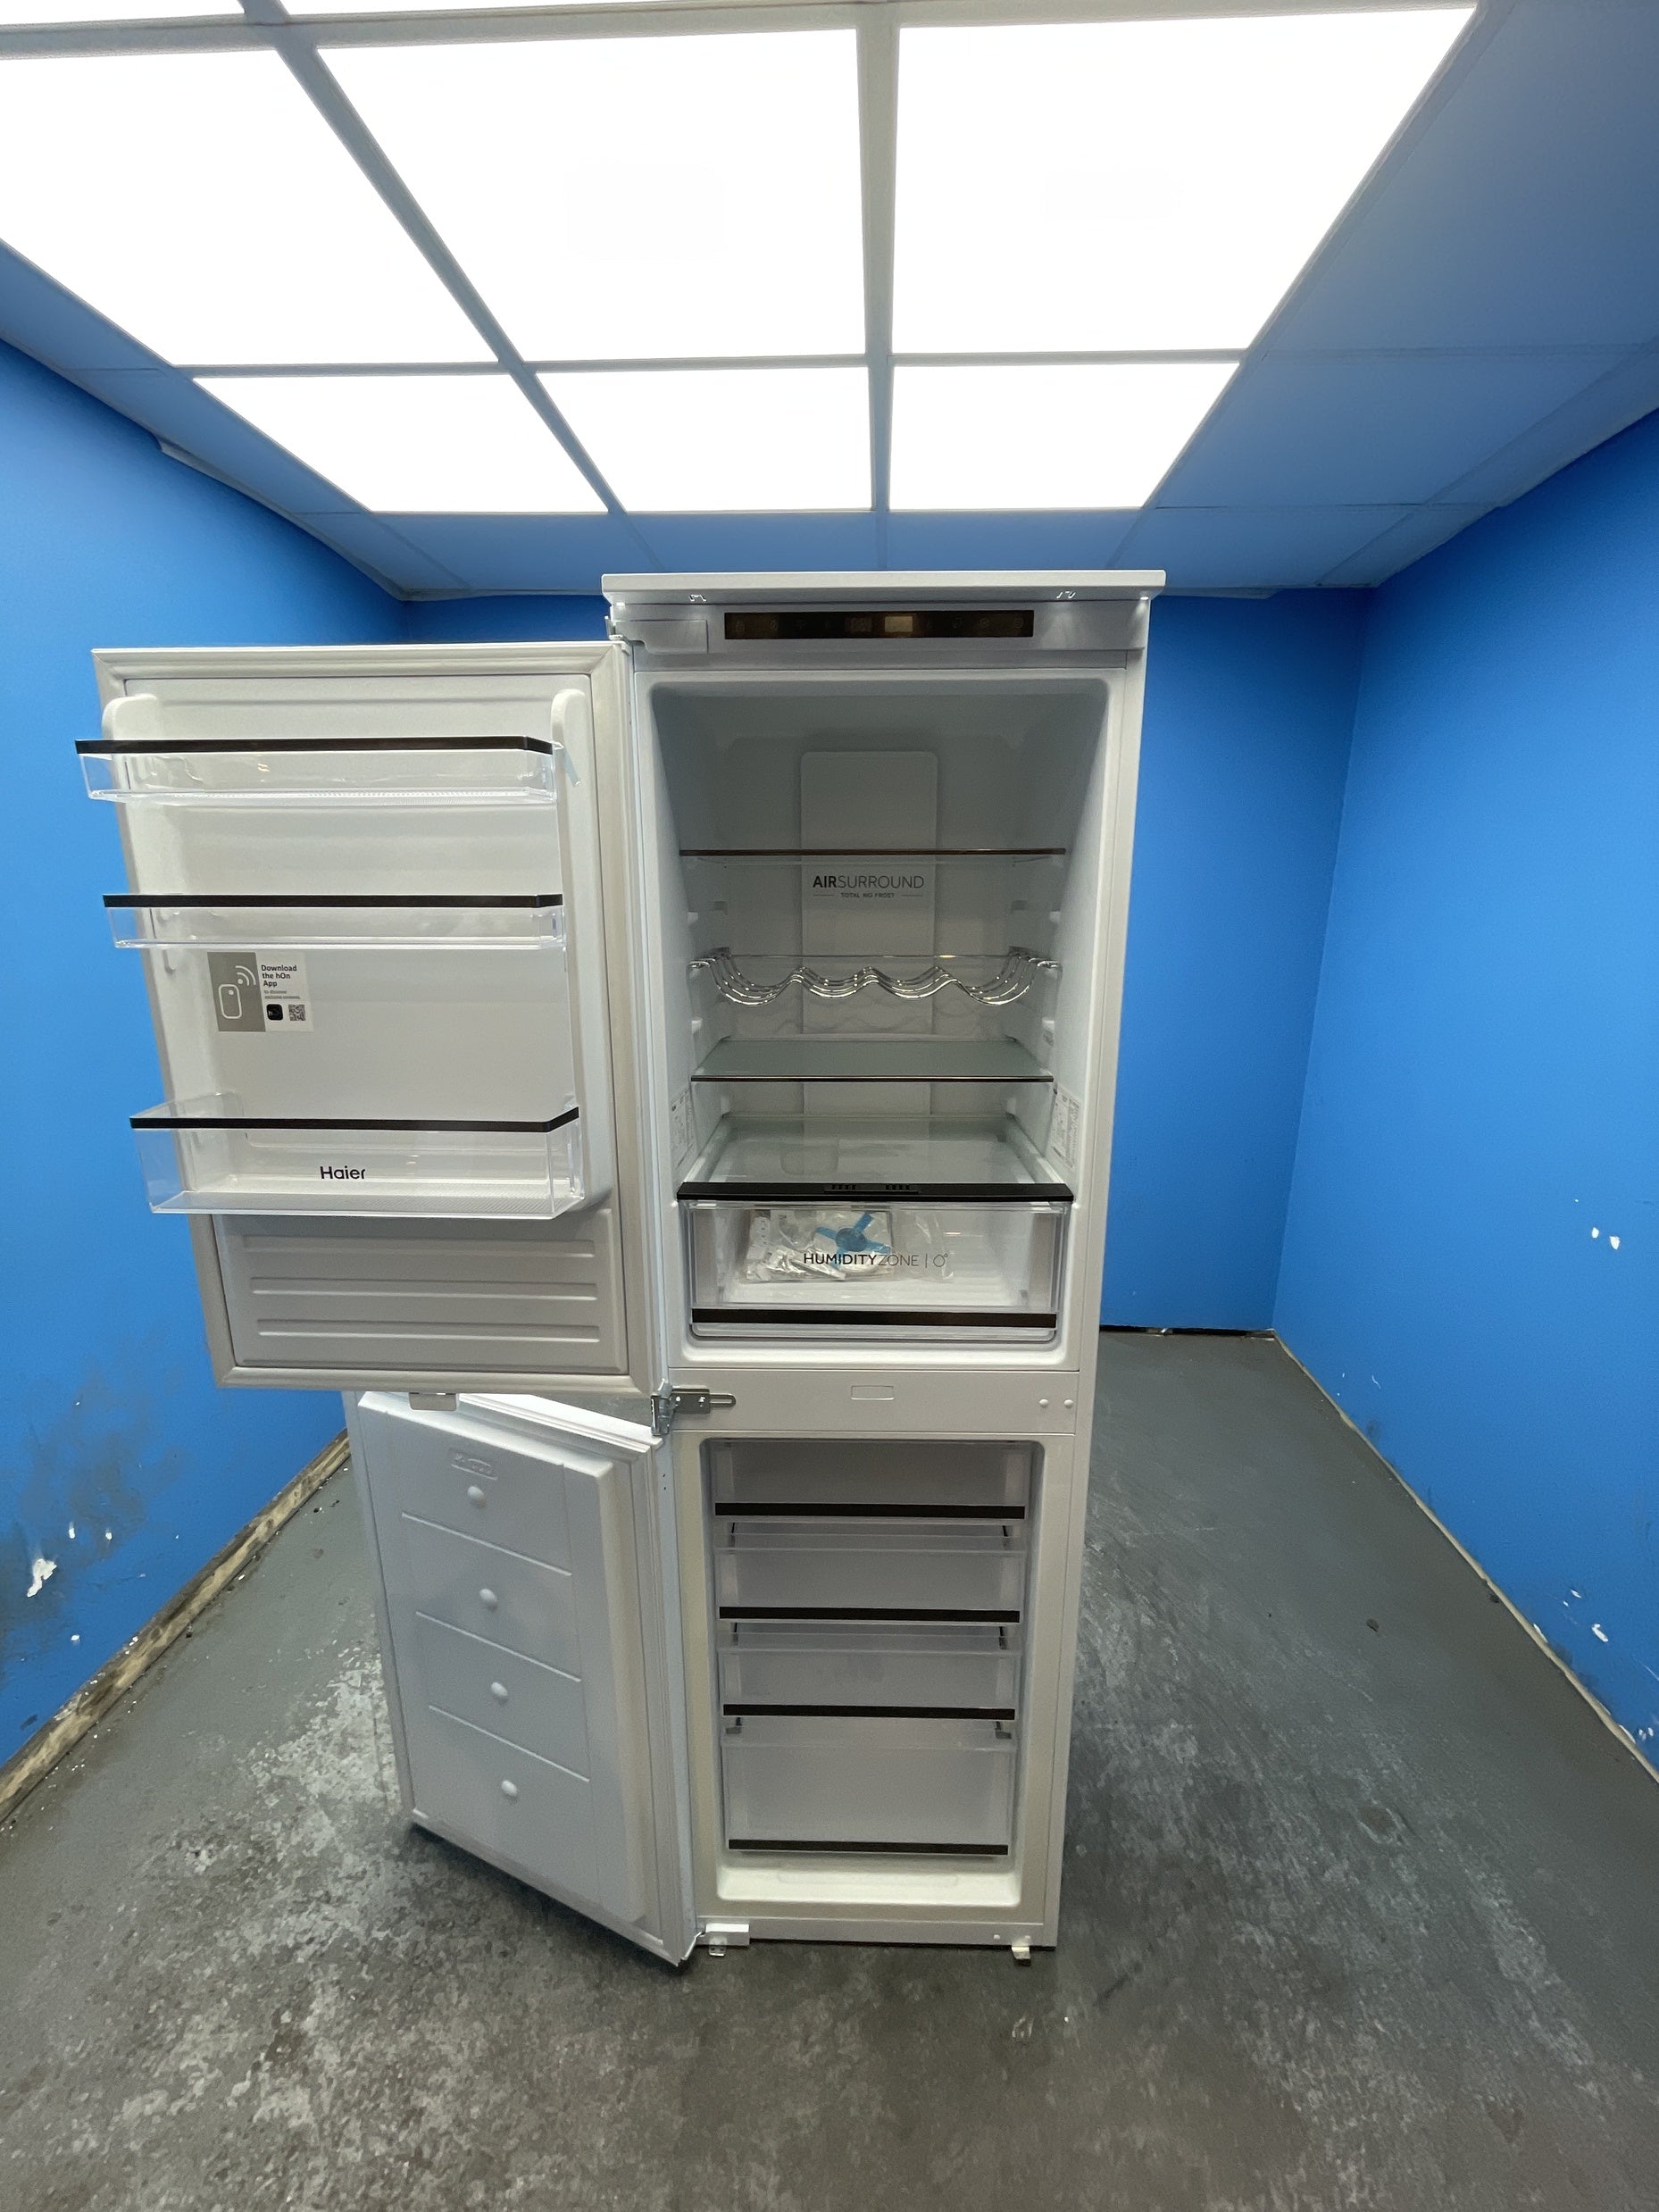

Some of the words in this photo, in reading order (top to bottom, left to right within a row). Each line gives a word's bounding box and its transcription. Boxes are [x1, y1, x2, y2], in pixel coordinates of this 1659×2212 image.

[813, 875, 925, 889] AIRSURROUND
[263, 980, 278, 988] App
[320, 1164, 366, 1180] Haier
[804, 1253, 920, 1266] HUMIDITYZONE
